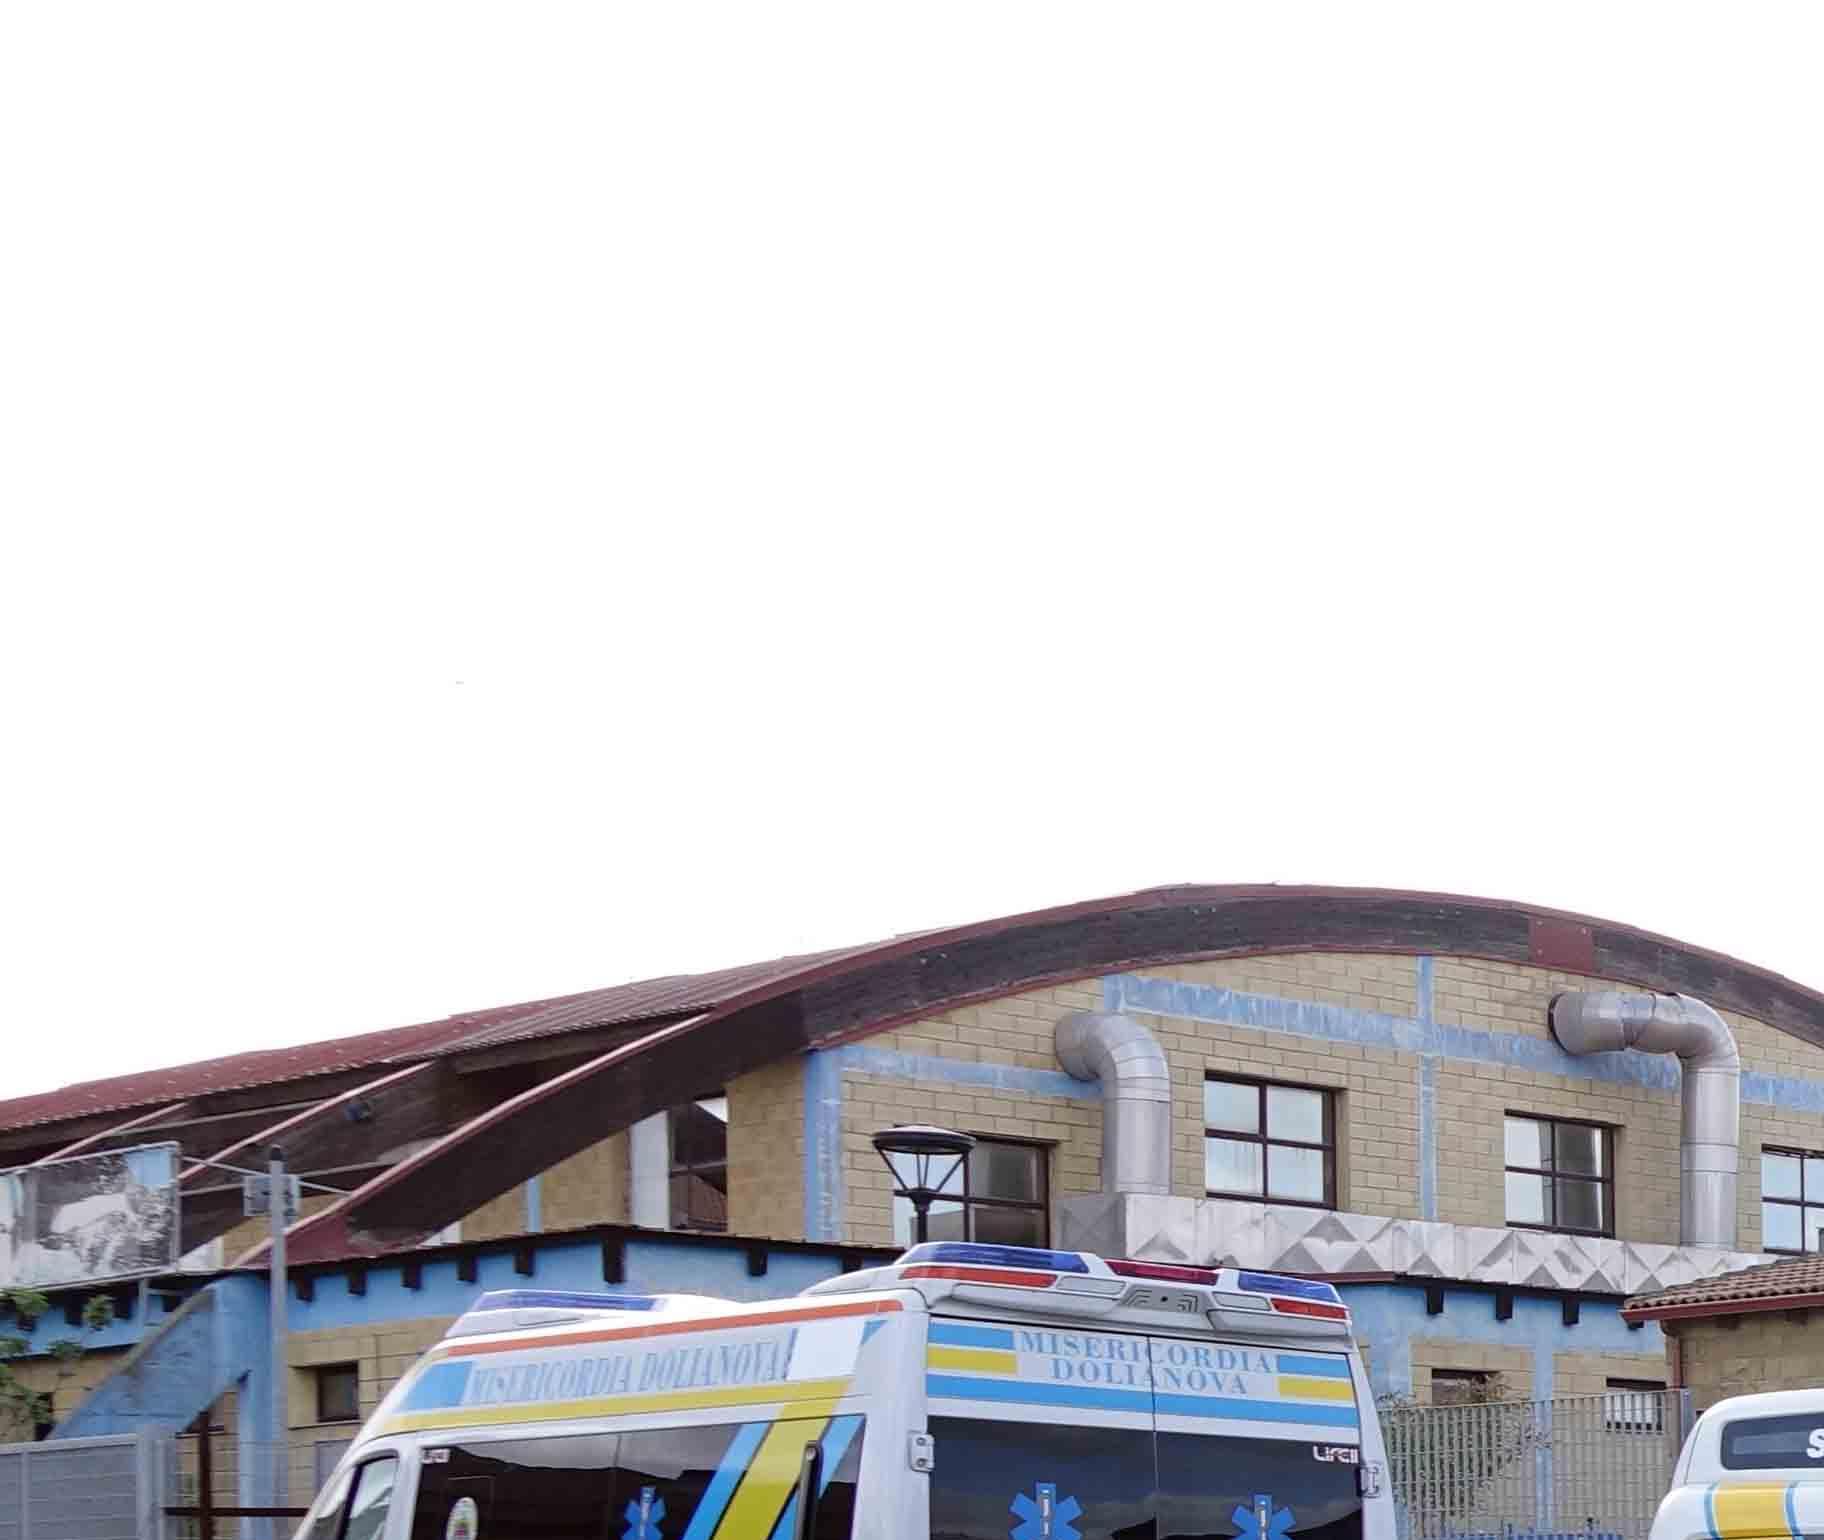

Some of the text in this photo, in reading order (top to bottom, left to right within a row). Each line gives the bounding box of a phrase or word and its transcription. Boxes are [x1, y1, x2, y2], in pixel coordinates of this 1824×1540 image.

[469, 1341, 786, 1404] MISERICORDIA DOLIANOVA
[1019, 1330, 1279, 1373] MISERICORDIA
[1053, 1357, 1248, 1394] DOLIANOVA
